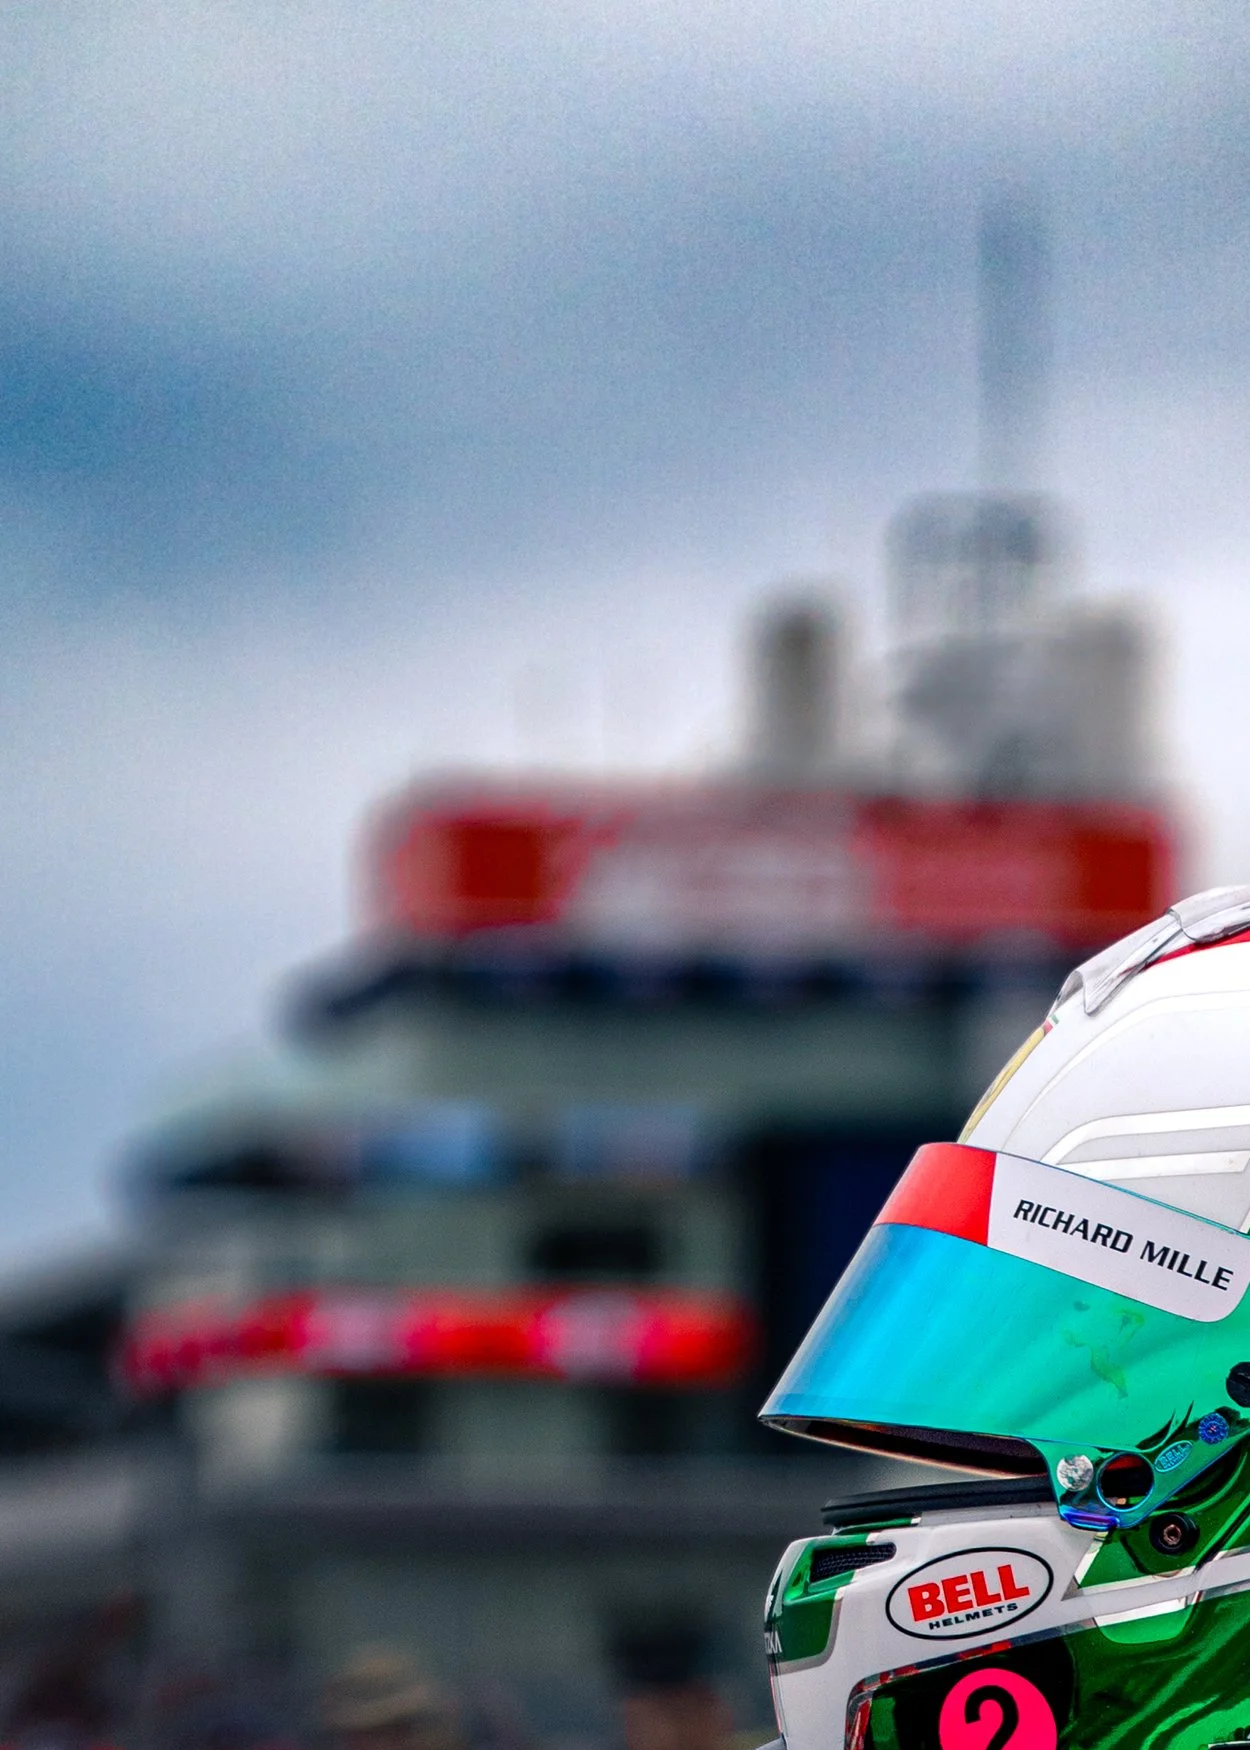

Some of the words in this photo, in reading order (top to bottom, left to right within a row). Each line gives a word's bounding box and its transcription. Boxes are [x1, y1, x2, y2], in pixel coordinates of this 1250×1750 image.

[1013, 1199, 1133, 1254] RICHARD
[1140, 1240, 1234, 1291] MILLE
[907, 1564, 1031, 1622] BELL
[928, 1602, 1019, 1631] HELMETS
